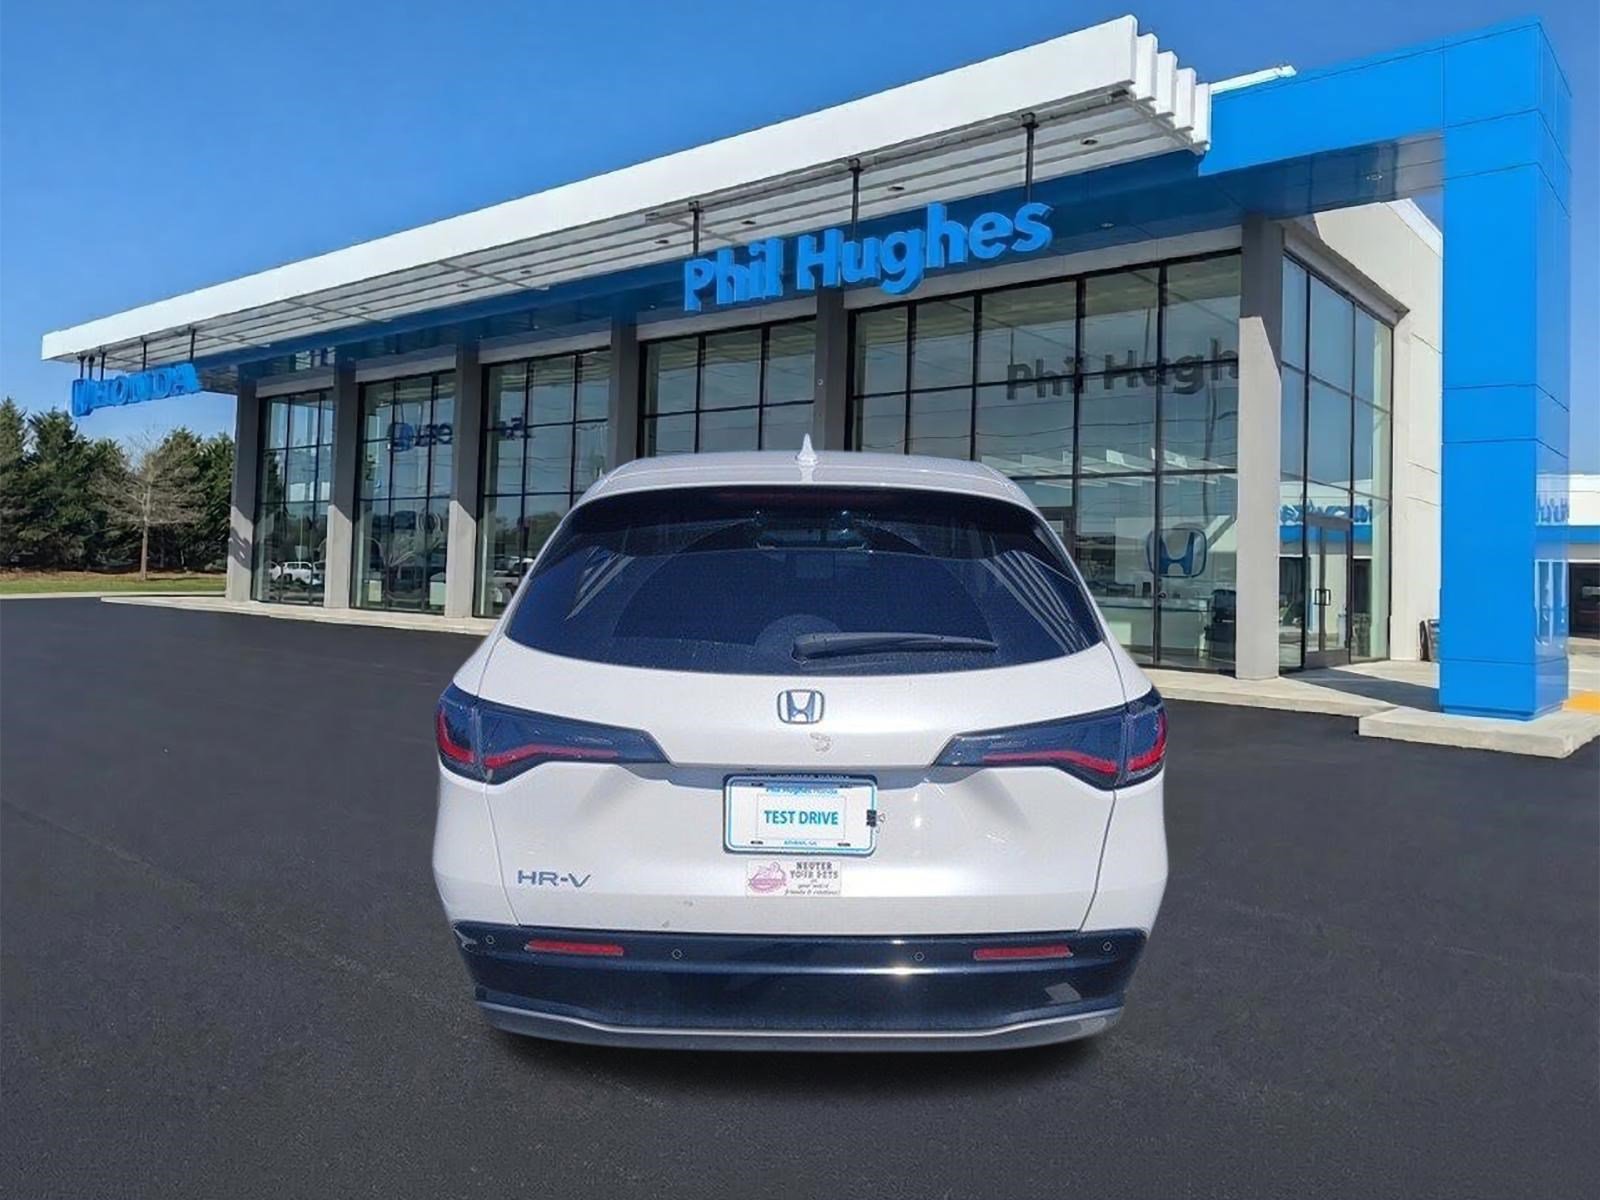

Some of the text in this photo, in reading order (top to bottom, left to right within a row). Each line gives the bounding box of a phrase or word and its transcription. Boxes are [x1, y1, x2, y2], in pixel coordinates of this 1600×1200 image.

[684, 201, 1053, 312] Phil Hughes
[764, 810, 839, 825] TEST DRIVE
[796, 861, 832, 870] NEUTER
[517, 869, 591, 888] HR-V
